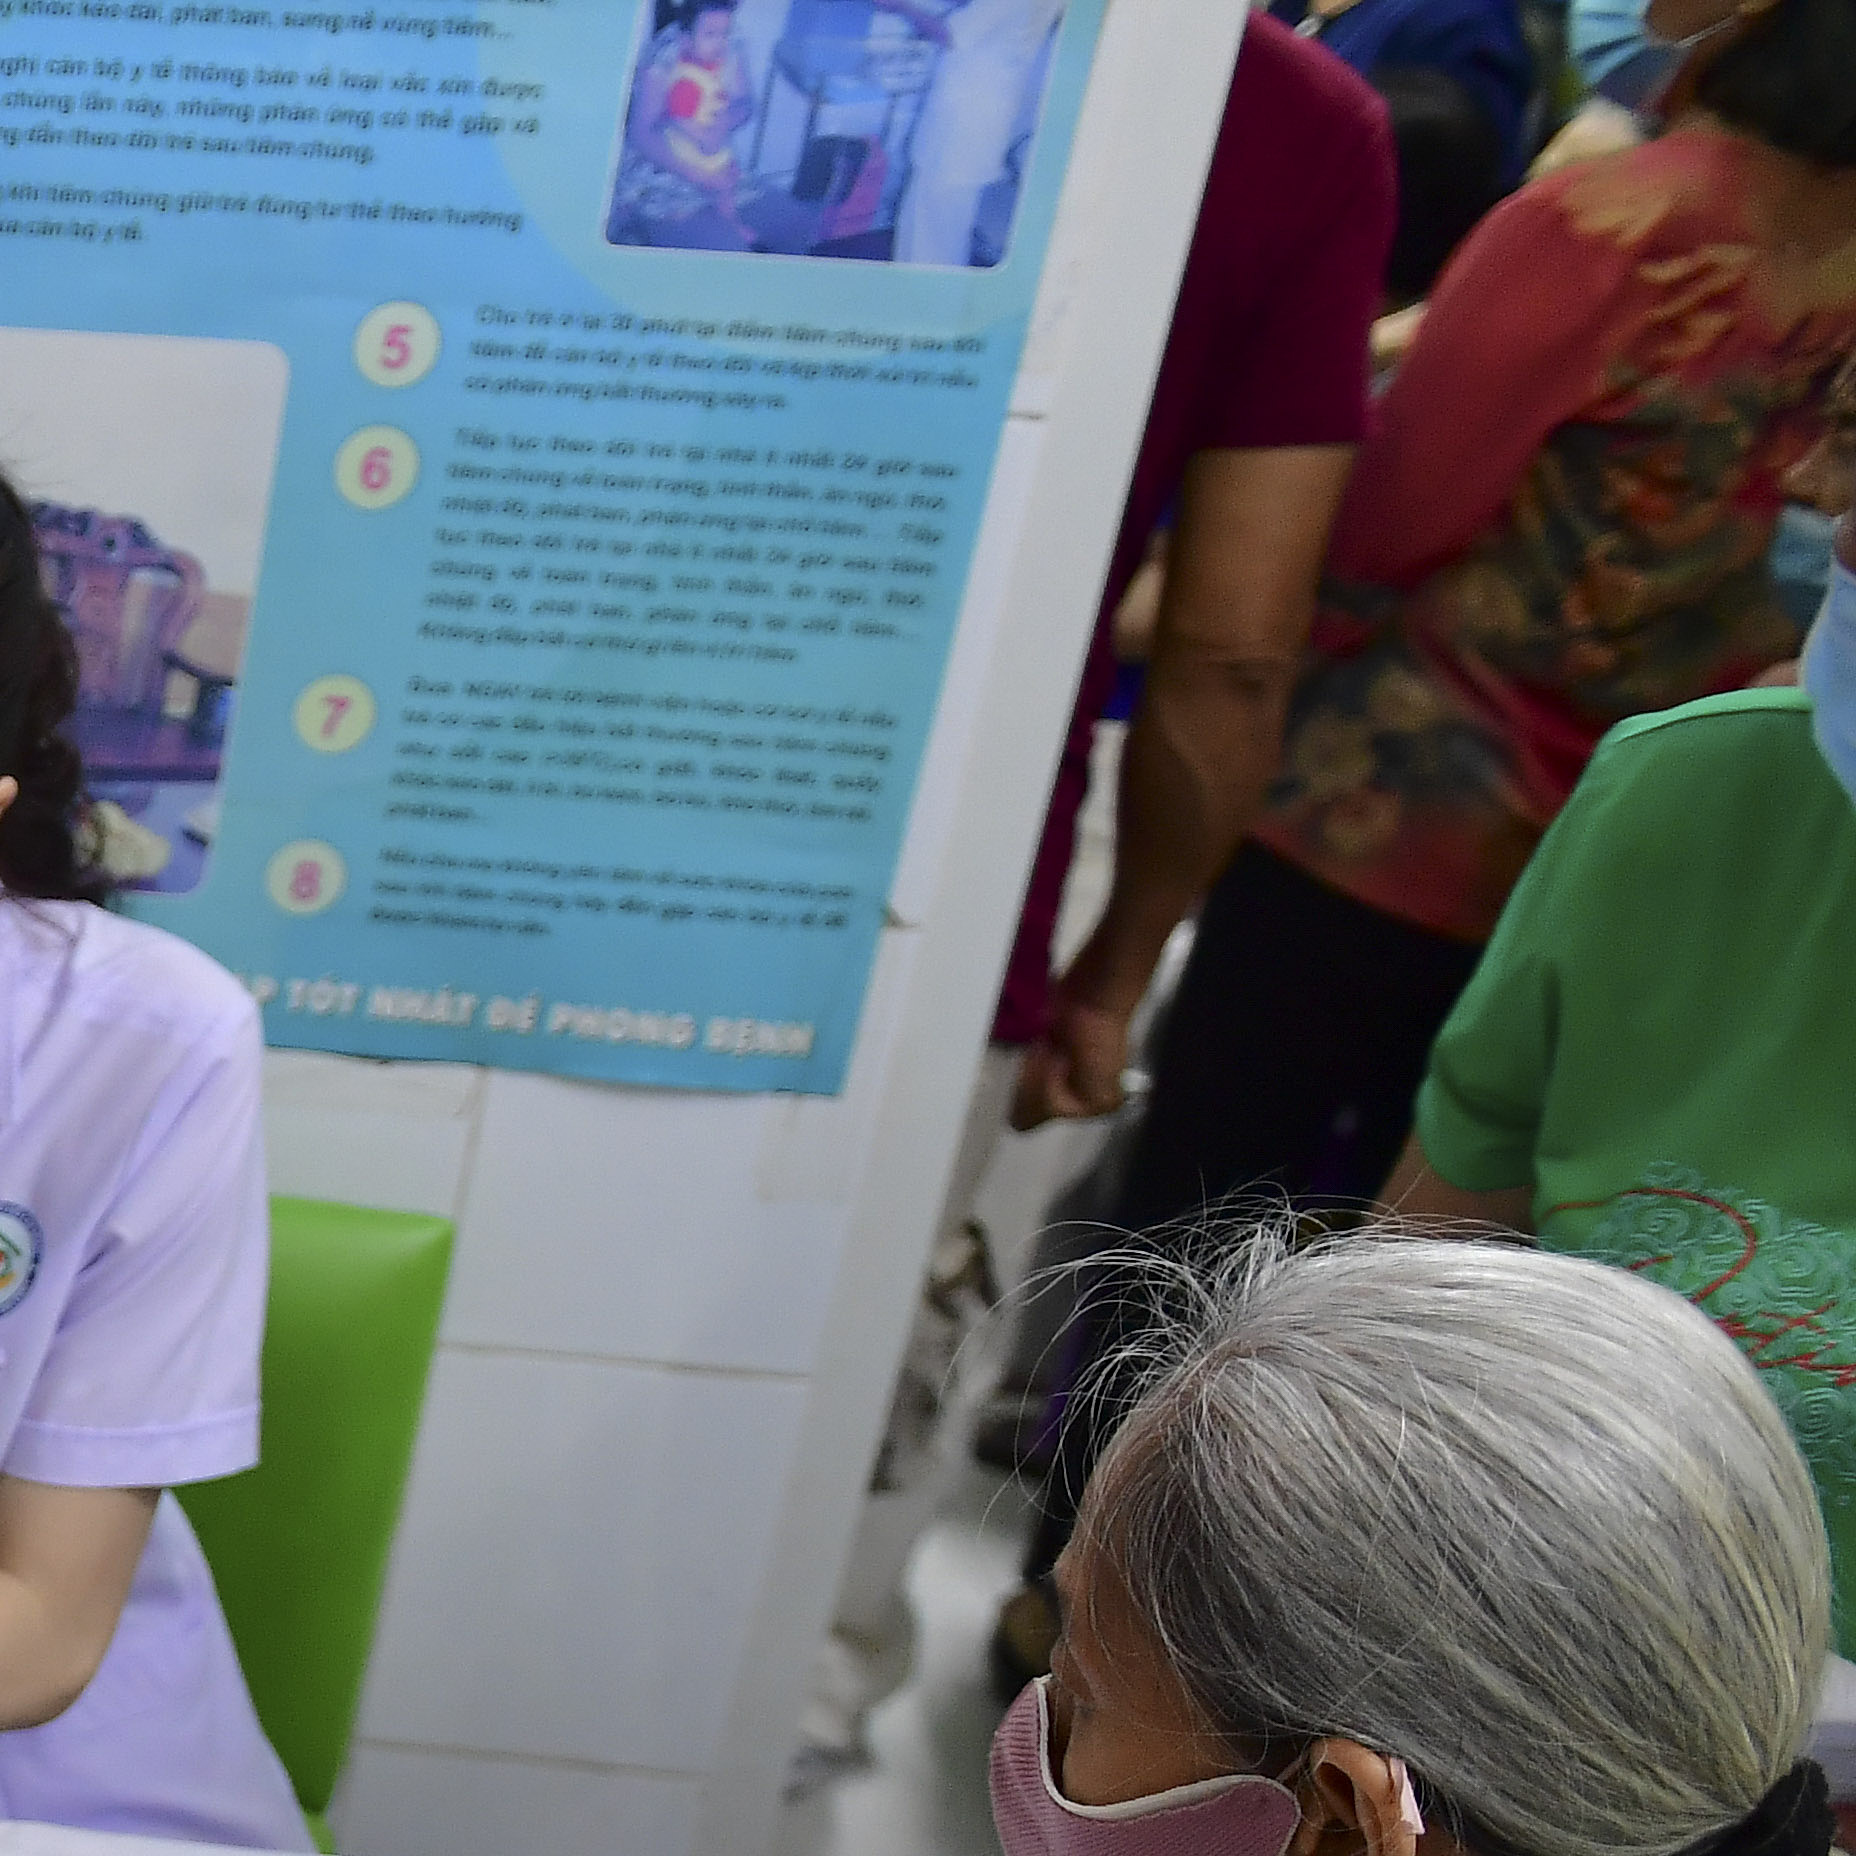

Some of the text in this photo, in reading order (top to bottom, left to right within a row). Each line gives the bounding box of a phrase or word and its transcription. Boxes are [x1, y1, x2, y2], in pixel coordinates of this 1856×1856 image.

[380, 325, 413, 369] 5
[359, 447, 394, 491] 6
[318, 694, 352, 739] 7
[288, 860, 322, 901] 8
[287, 972, 360, 1015] TỐT
